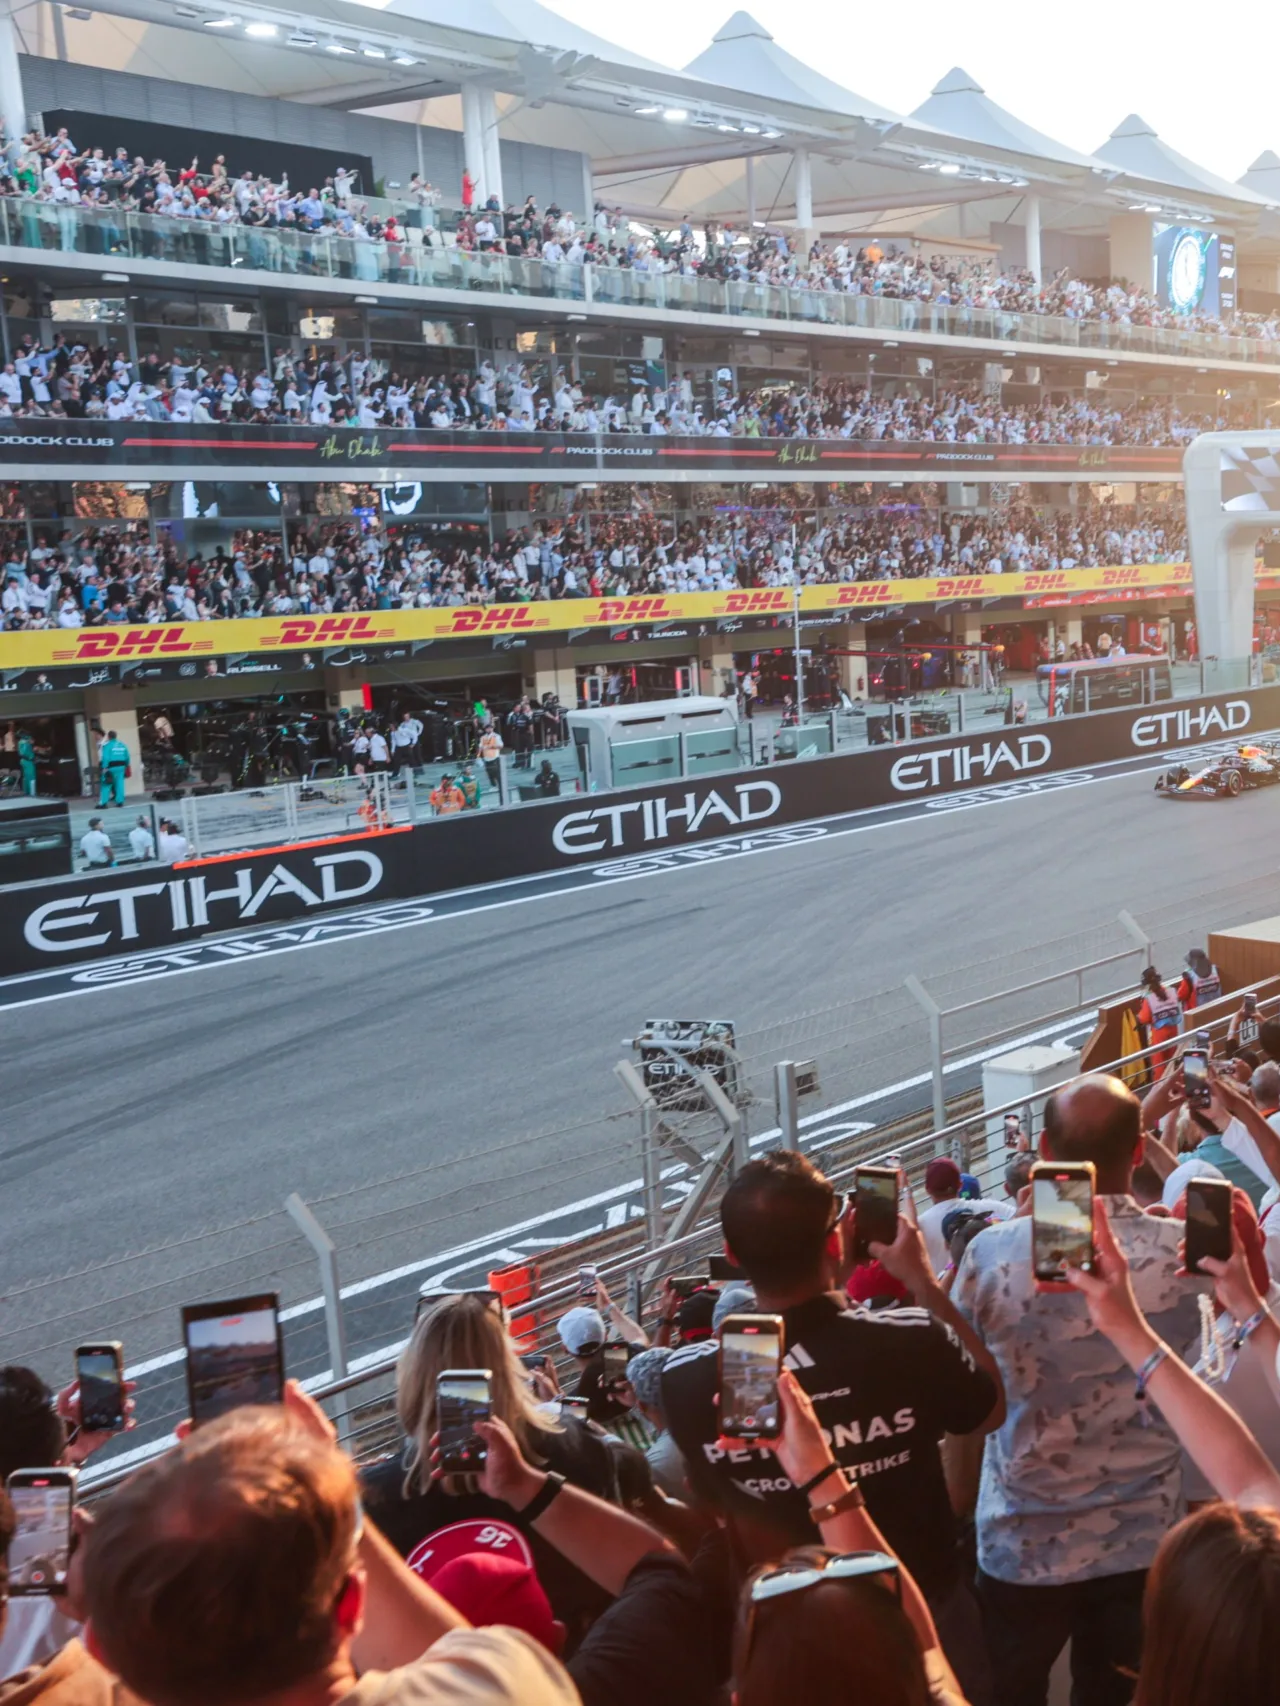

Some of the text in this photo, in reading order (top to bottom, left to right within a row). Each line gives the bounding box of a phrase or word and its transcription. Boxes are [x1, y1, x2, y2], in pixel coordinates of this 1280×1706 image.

[66, 437, 115, 447] CLUB
[320, 434, 385, 459] Abu Dhabi
[566, 446, 653, 456] PADDOCK CLUB
[936, 452, 973, 461] PADDOCK
[936, 579, 986, 598] DHL
[1024, 573, 1068, 592] DHL
[1102, 568, 1143, 586] DHL
[725, 591, 789, 613] DHL
[837, 585, 893, 605] DHL
[451, 607, 537, 633] DHL
[598, 598, 671, 622] DHL
[280, 616, 378, 645] DHL
[76, 628, 194, 659] DHL
[227, 663, 282, 675] RUSSELL
[1131, 700, 1252, 748] ETIHAD
[890, 733, 1053, 792] ETIHAD
[925, 773, 1095, 809] ETIHAD
[552, 780, 782, 855] ETIHAD
[592, 827, 829, 877] ETIHAD
[23, 850, 384, 953] ETIHAD
[70, 906, 434, 984] ETIHAD
